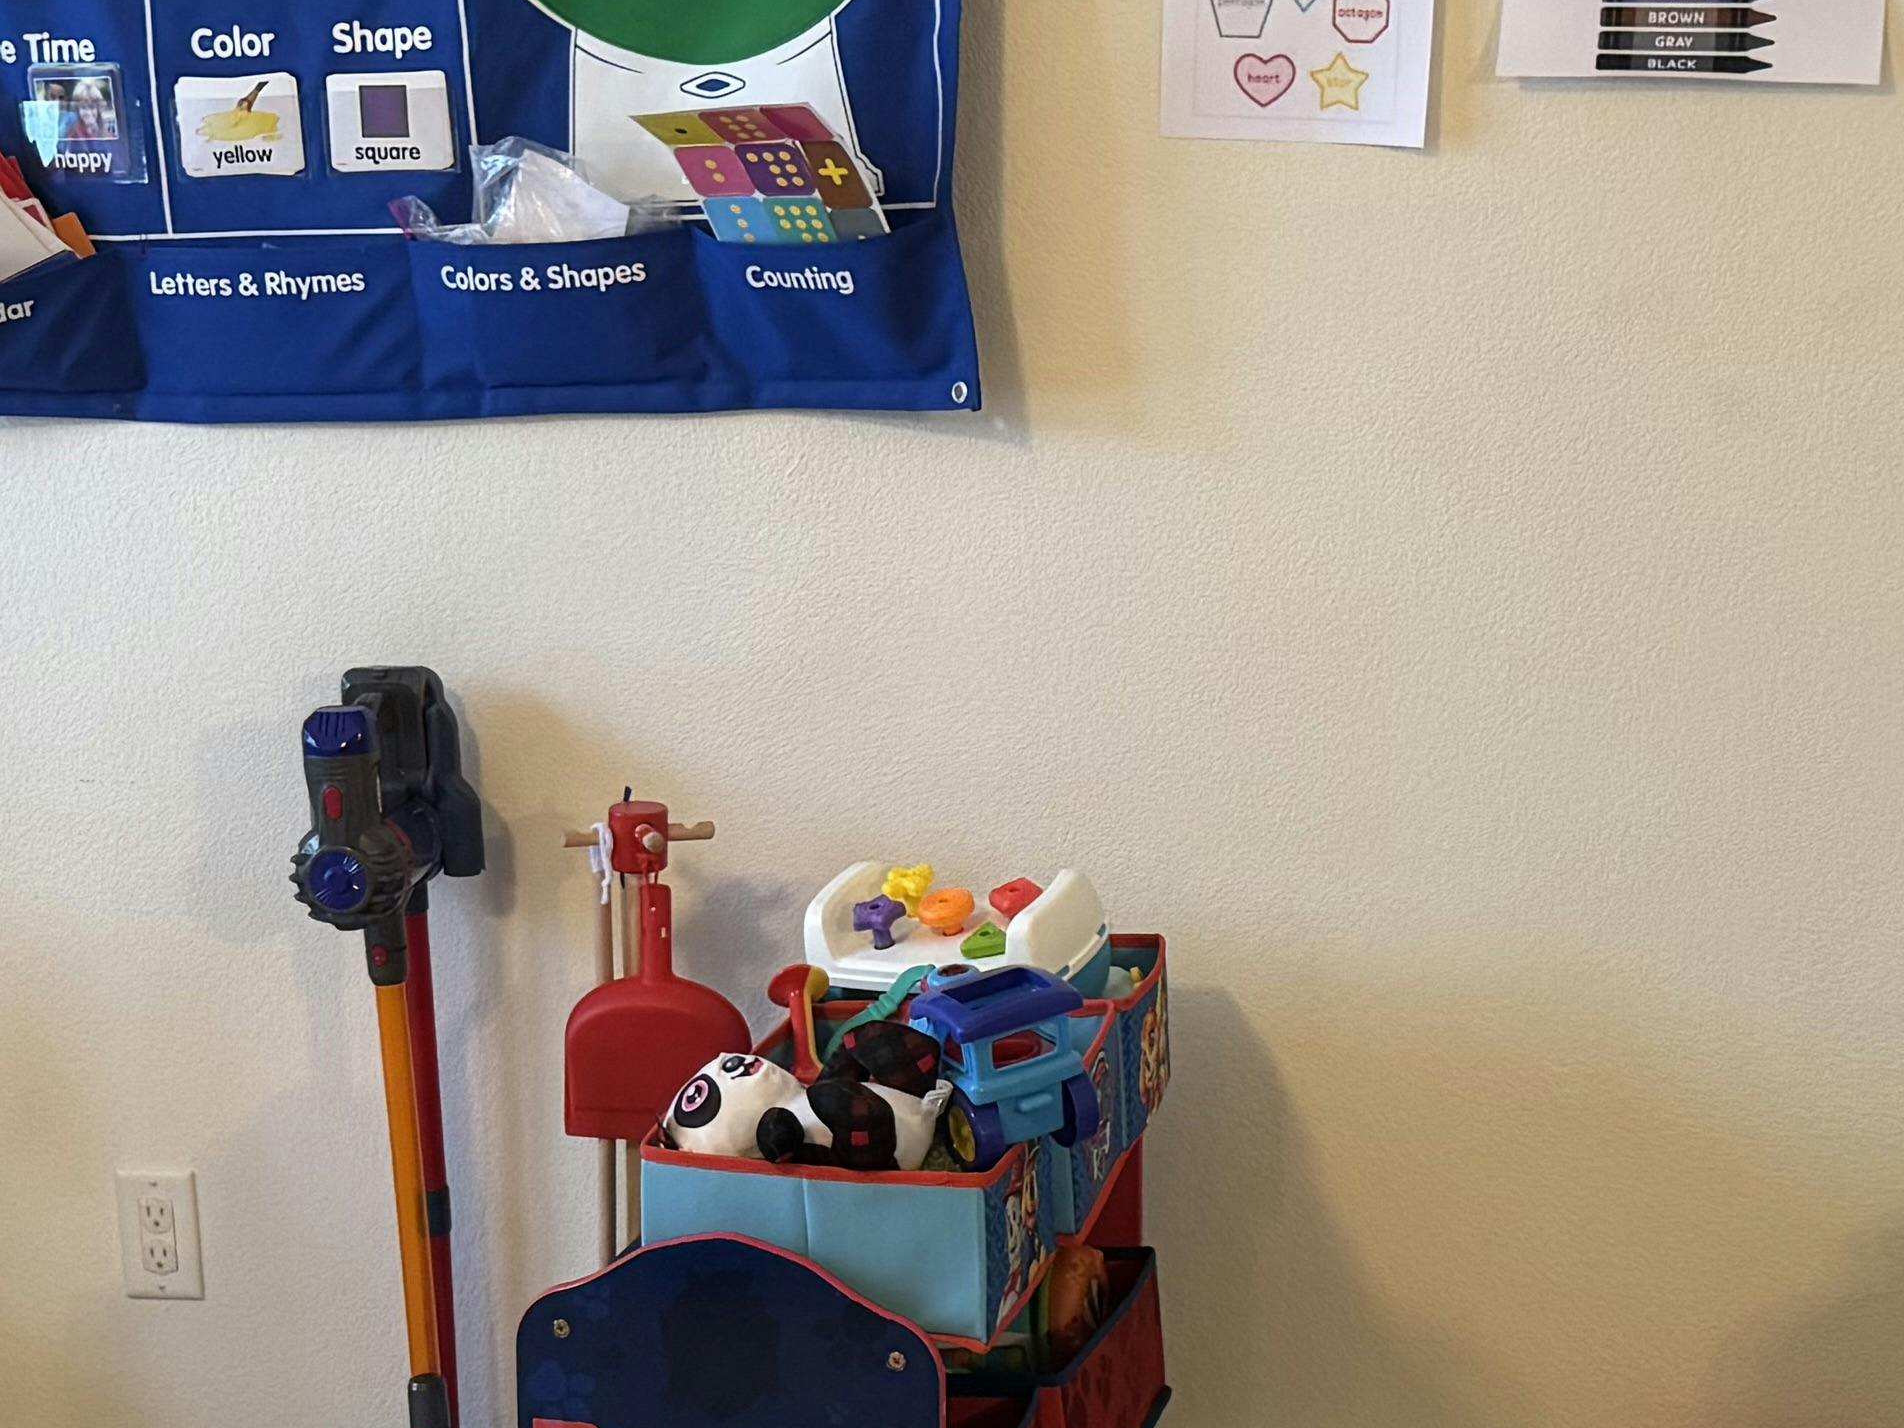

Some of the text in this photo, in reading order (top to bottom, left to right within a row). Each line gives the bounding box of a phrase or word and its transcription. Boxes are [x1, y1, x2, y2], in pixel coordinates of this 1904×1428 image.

[1338, 7, 1383, 21] octagon
[1648, 11, 1705, 25] BROWN
[22, 32, 96, 64] Time
[190, 24, 276, 59] Color
[332, 20, 434, 60] Shape
[1655, 36, 1694, 48] GRAY
[1647, 58, 1696, 70] BLACK
[1247, 72, 1281, 85] heart
[55, 150, 113, 174] happy
[212, 145, 274, 170] yellow
[354, 144, 422, 166] square
[150, 270, 367, 301] Letters & Rhymes
[440, 261, 648, 293] Colors & Shapes
[745, 265, 856, 295] Counting
